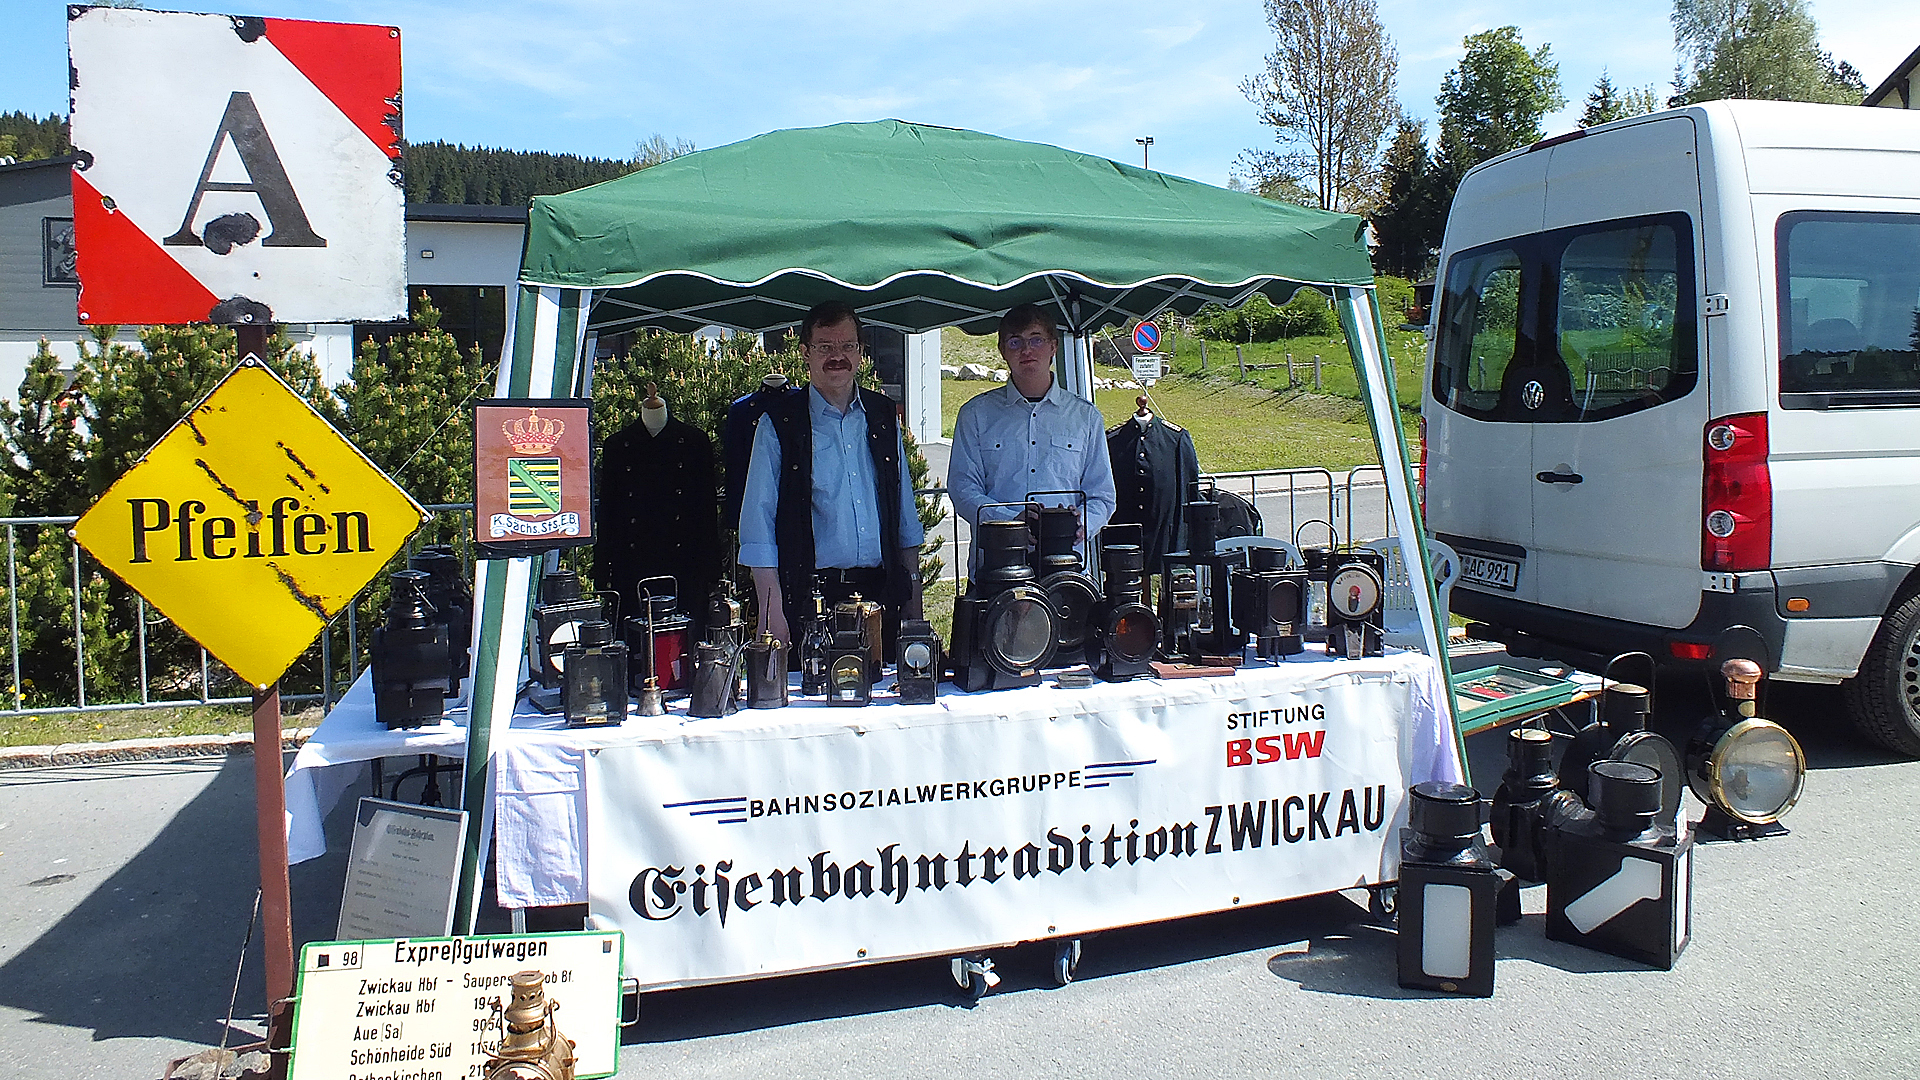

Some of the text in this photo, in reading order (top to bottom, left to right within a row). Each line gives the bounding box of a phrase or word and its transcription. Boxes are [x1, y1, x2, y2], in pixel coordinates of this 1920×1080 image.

[163, 91, 327, 247] A
[127, 496, 375, 564] Pfeifen
[1468, 558, 1509, 583] AC 991
[1227, 703, 1326, 730] STIFTUNG
[1226, 730, 1326, 768] BSW
[749, 770, 1082, 819] BAHNSOZIALWERKGRUPPE
[1203, 784, 1386, 856] ZWICKAU
[342, 951, 358, 966] 98
[395, 938, 548, 967] Expreßgutwagen
[359, 978, 412, 996] Zwickau
[418, 976, 438, 991] Hbf
[356, 1000, 410, 1018] Zwickau
[416, 998, 436, 1013] Hbf
[353, 1025, 378, 1041] Aue
[350, 1043, 425, 1065] Schönheide
[429, 1042, 452, 1059] Süd
